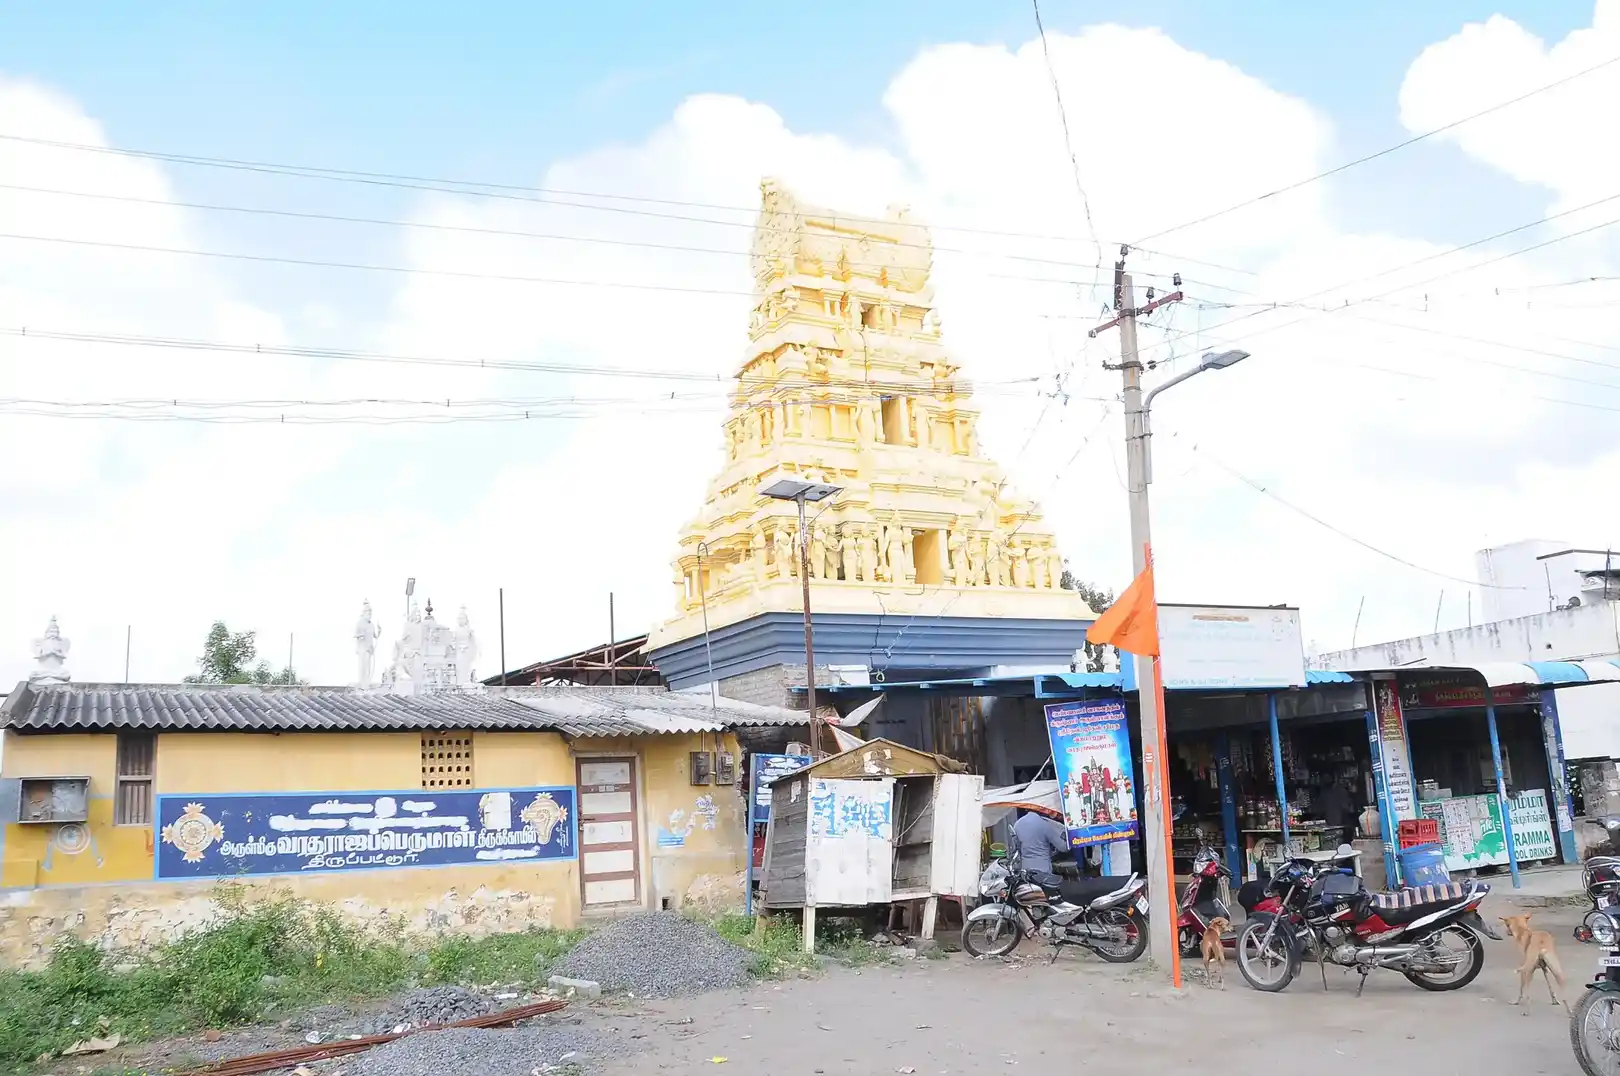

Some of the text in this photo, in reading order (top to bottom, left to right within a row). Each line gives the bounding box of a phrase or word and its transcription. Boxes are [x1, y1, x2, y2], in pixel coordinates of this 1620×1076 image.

[219, 829, 276, 857] அருள்மிகு
[1514, 830, 1550, 847] RAMMA
[1515, 846, 1553, 859] OOL DRINKS
[1335, 902, 1350, 912] YAM
